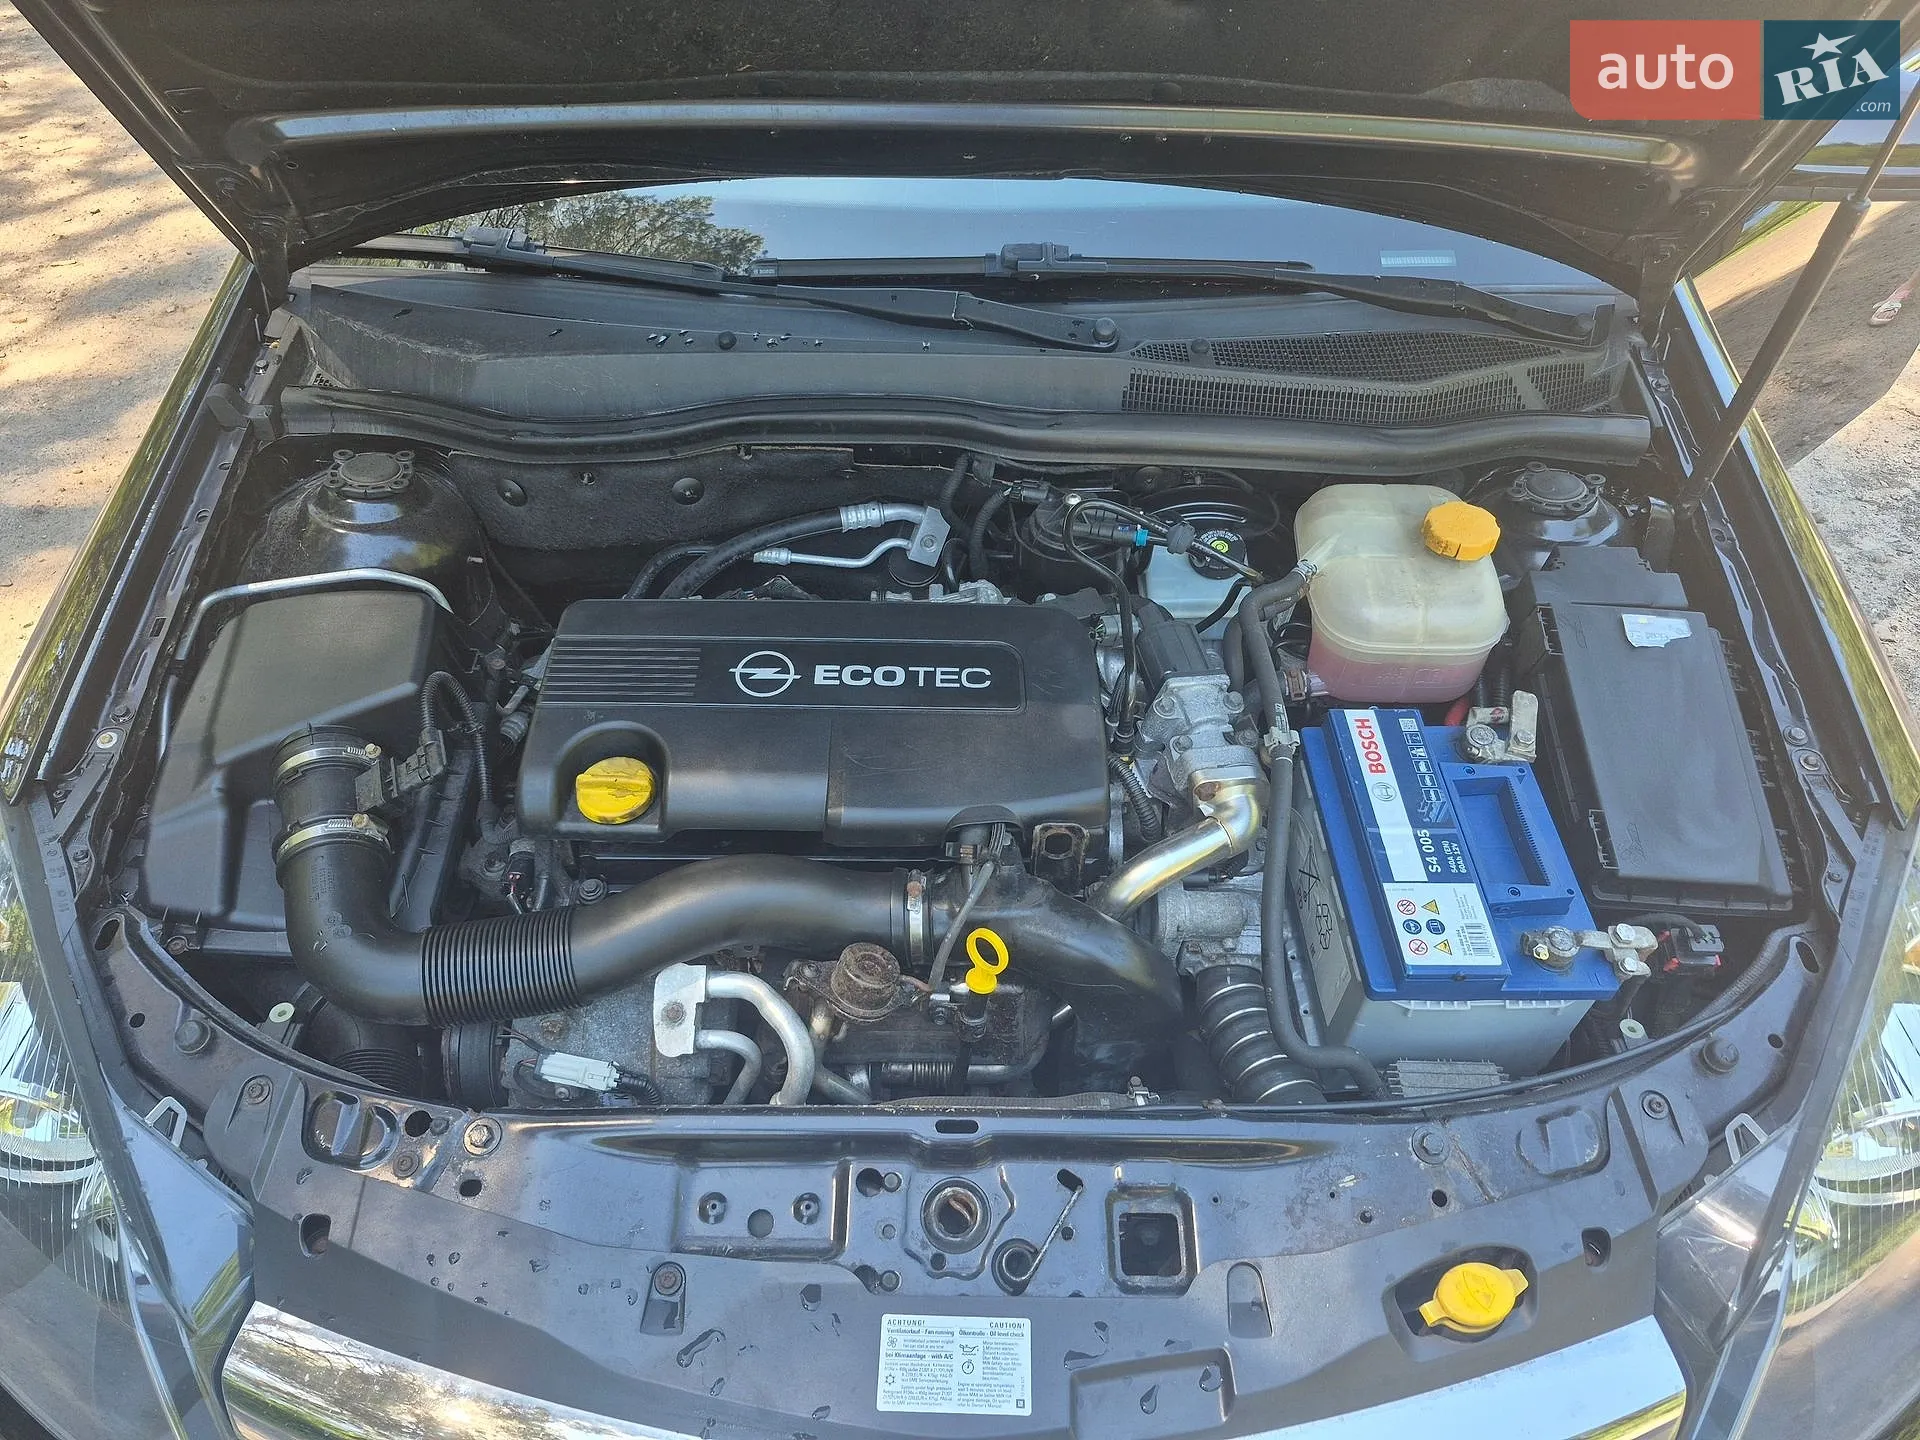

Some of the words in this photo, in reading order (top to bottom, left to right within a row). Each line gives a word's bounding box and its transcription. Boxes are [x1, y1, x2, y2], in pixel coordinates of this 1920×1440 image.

[813, 664, 992, 689] ECOTEC
[1354, 718, 1387, 774] BOSCH
[1417, 828, 1435, 853] 005
[1451, 842, 1461, 855] 12V
[1425, 855, 1442, 873] S4
[1455, 856, 1467, 873] 60Ah
[989, 1321, 1025, 1329] CAUTION!
